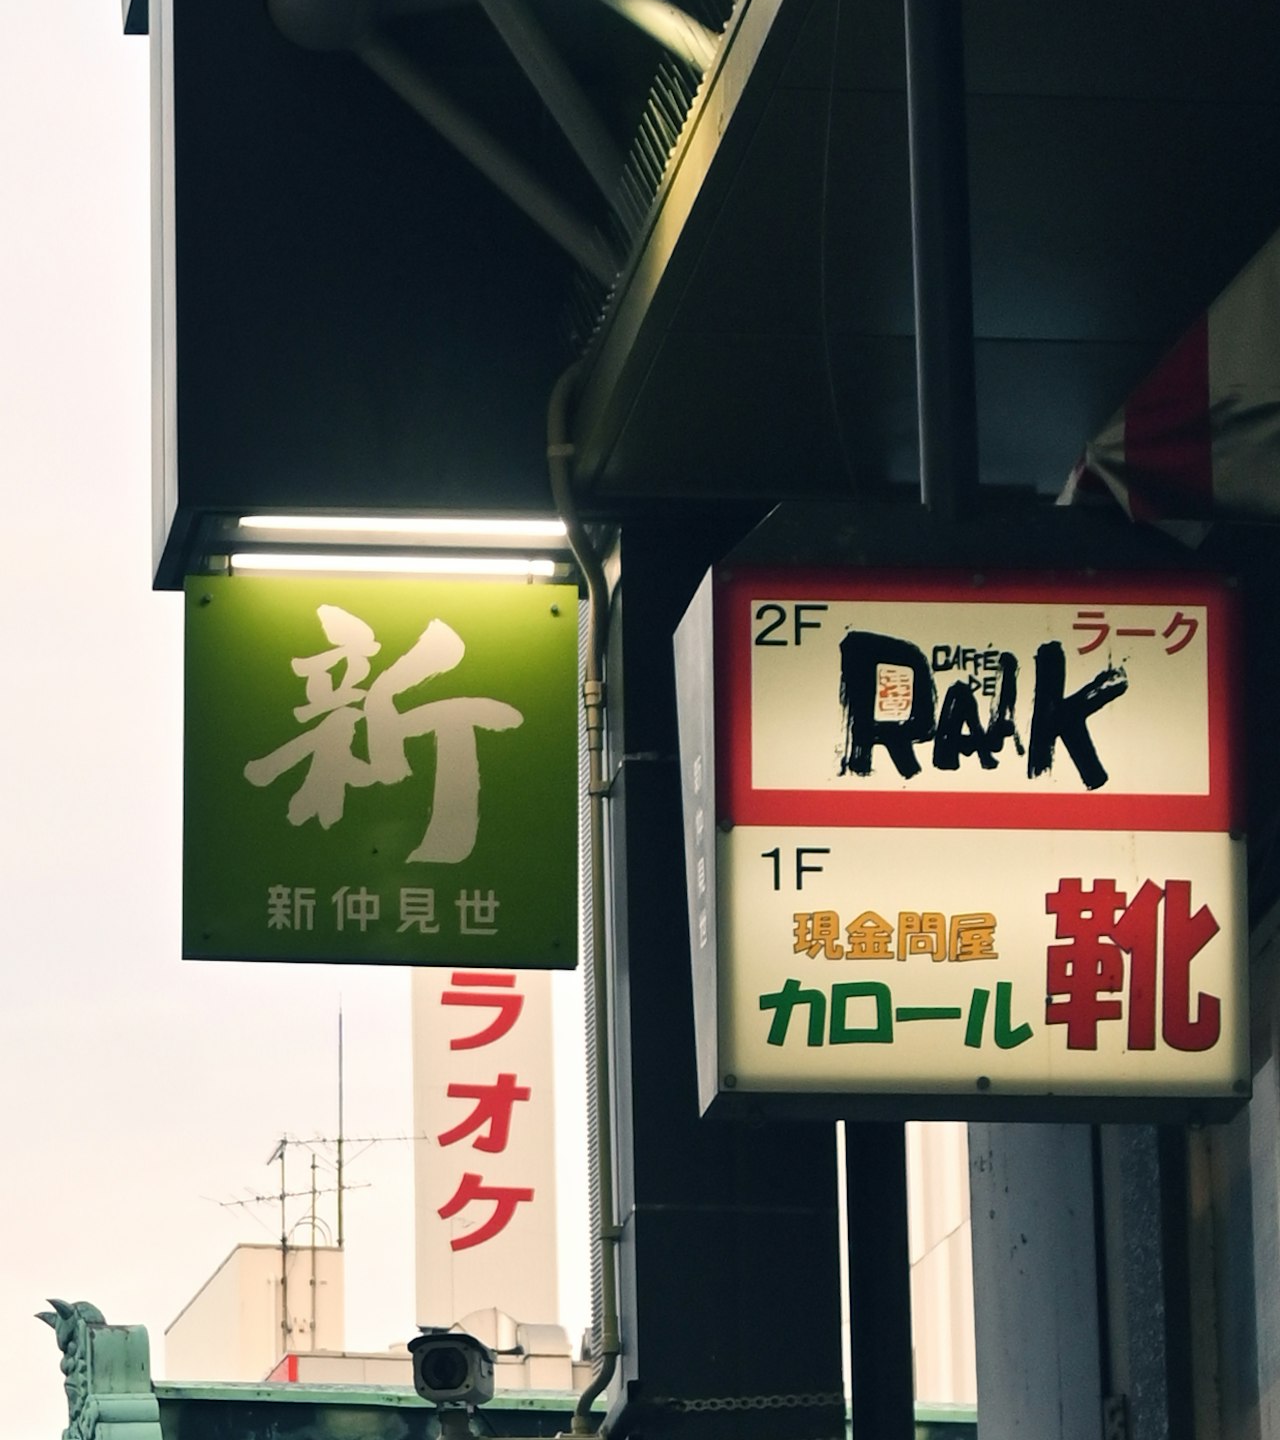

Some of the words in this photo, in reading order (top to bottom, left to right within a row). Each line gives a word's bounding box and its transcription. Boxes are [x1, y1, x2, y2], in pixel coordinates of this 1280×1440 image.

[754, 603, 829, 646] 2F
[1072, 611, 1199, 656] ラーク
[245, 605, 523, 864] 新
[761, 847, 831, 891] 1F
[267, 886, 500, 937] 新仲見世
[793, 911, 999, 962] 現金問屋
[1045, 878, 1221, 1052] 靴
[760, 978, 1034, 1050] カロール
